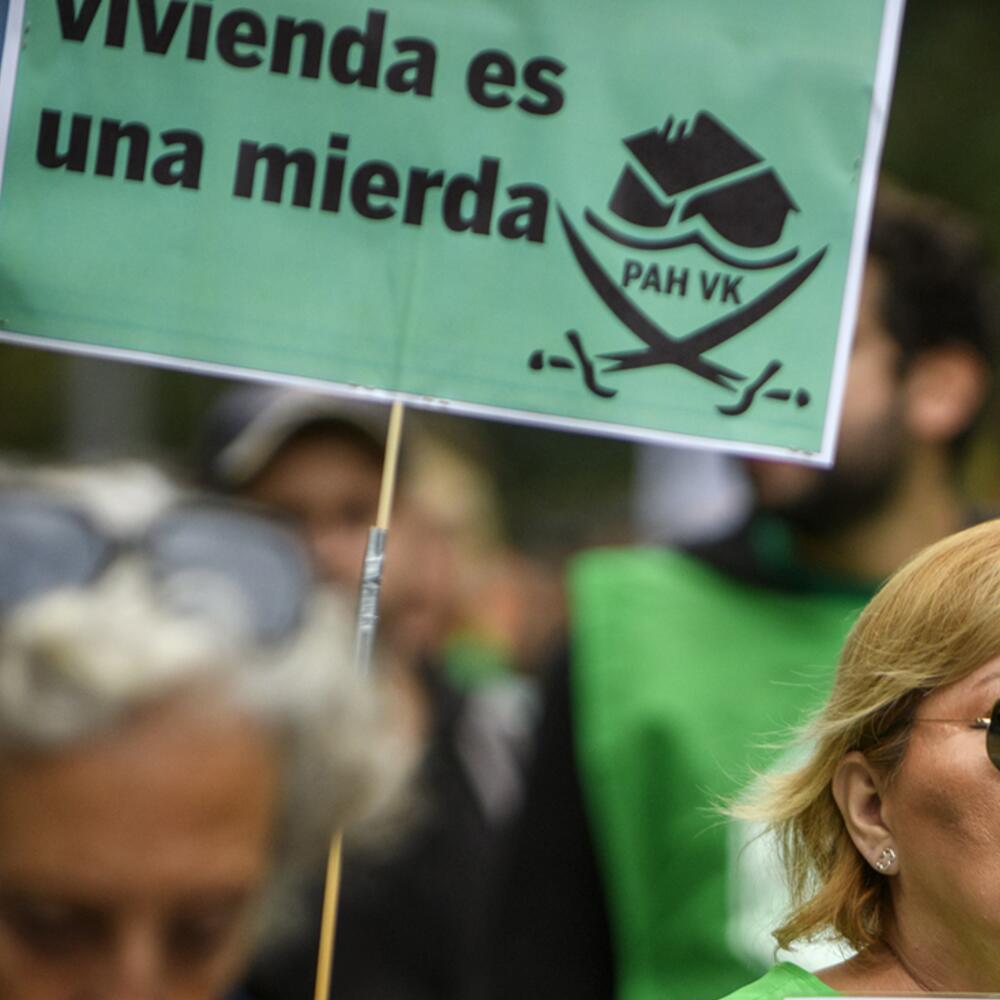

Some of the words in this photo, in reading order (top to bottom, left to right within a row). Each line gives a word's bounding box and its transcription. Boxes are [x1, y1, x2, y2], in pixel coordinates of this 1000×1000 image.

[56, 0, 437, 98] vivienda
[466, 50, 566, 116] es
[36, 108, 204, 191] una
[233, 133, 549, 244] mierda
[622, 261, 689, 297] PAH
[701, 272, 743, 305] VK
